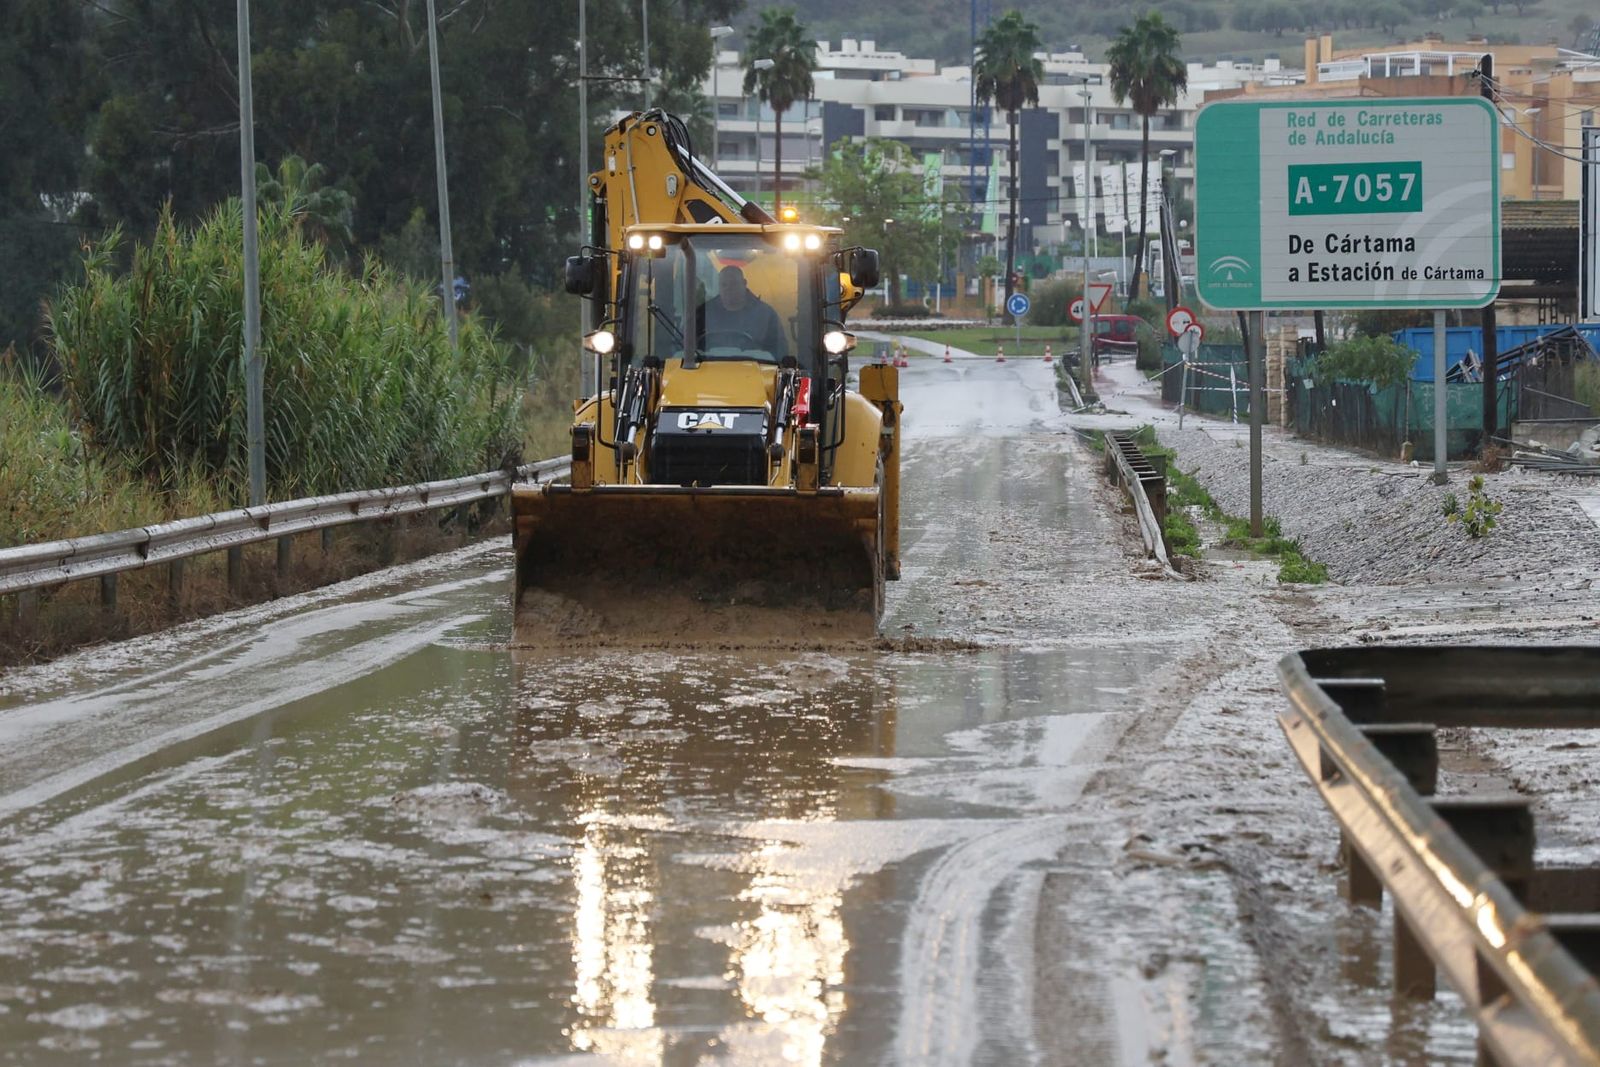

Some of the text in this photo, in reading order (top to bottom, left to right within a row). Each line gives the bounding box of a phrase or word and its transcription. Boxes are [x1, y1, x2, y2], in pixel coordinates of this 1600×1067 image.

[1288, 111, 1442, 127] Red de Carreteras
[1288, 130, 1394, 145] de Andalucía
[1295, 173, 1416, 204] A-7057
[1289, 233, 1415, 254] De Cártama
[1289, 262, 1484, 282] a Estación de Cártama
[677, 412, 740, 429] CAT
